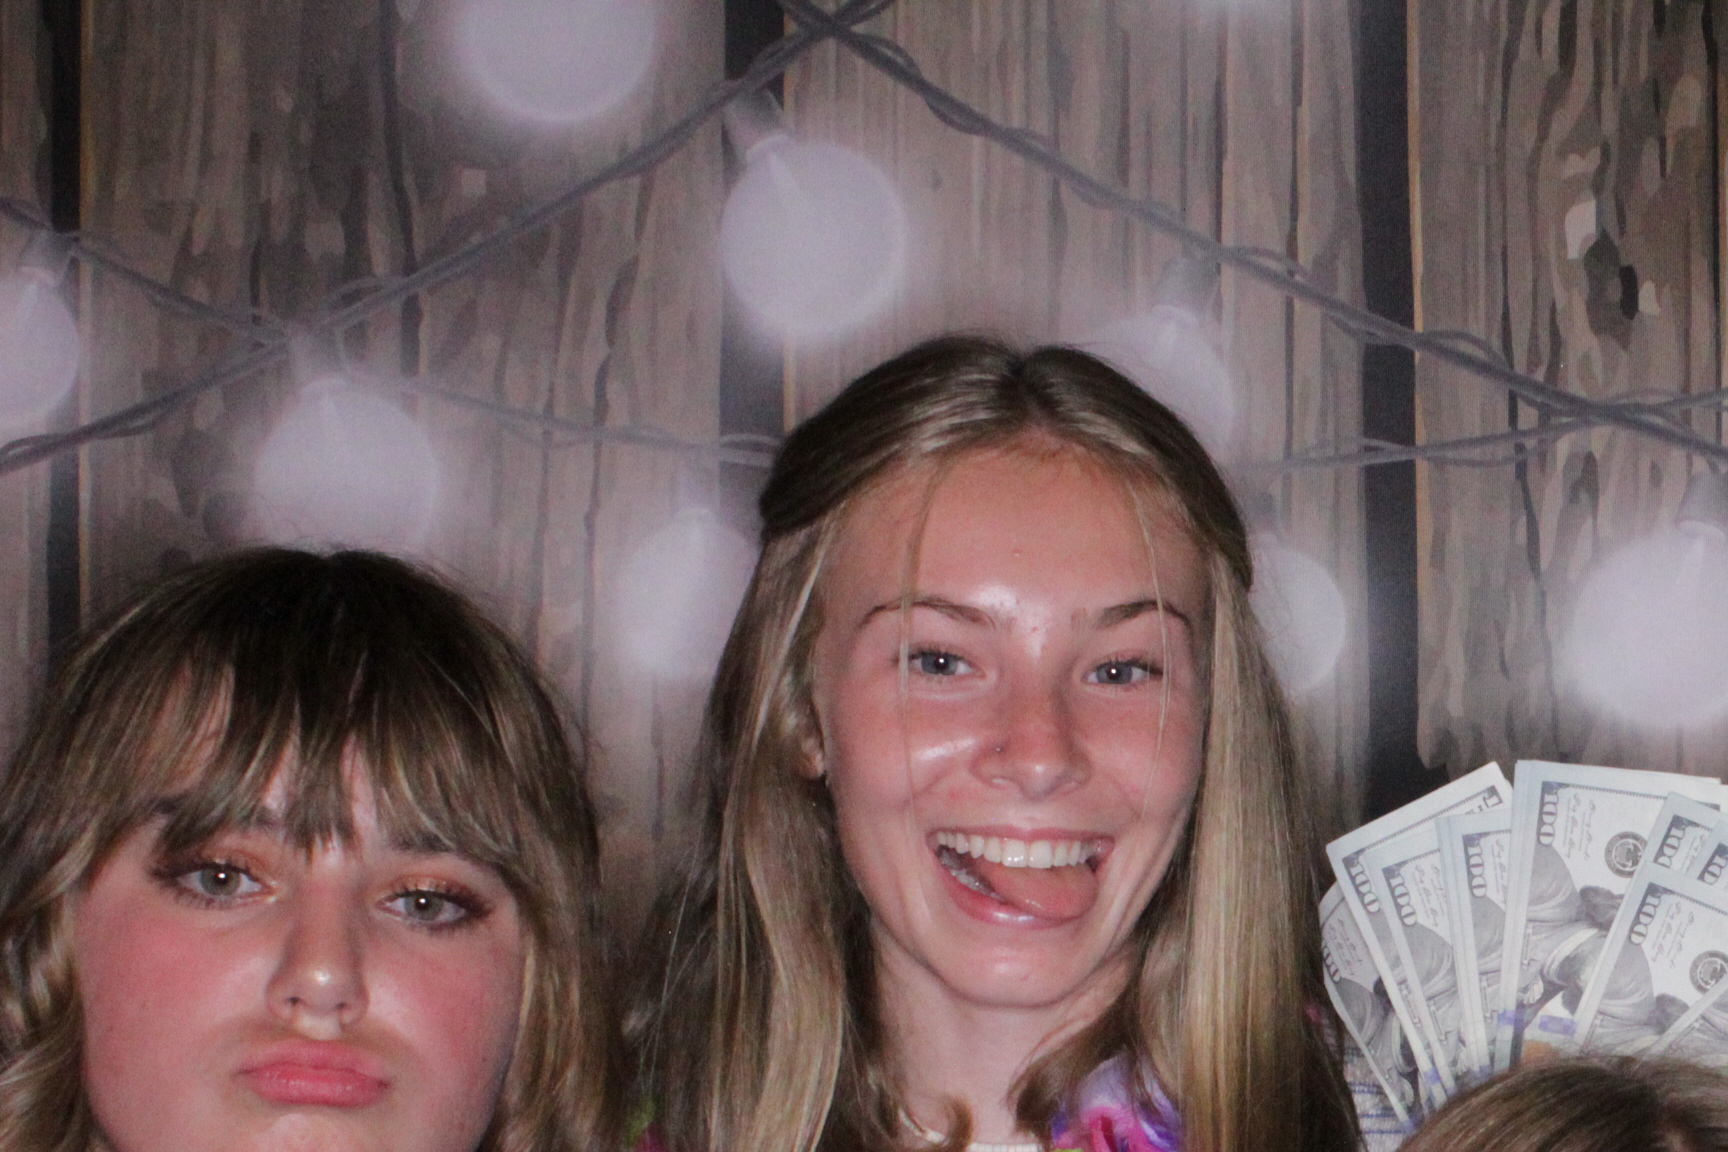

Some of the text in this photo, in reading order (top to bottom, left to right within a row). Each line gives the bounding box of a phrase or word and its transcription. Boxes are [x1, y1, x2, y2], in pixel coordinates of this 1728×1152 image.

[1537, 793, 1559, 846] 100
[1349, 861, 1381, 914] 100
[1466, 843, 1487, 898] 100
[1702, 855, 1728, 885] 10
[1389, 875, 1418, 927] 100
[1630, 894, 1661, 946] 100
